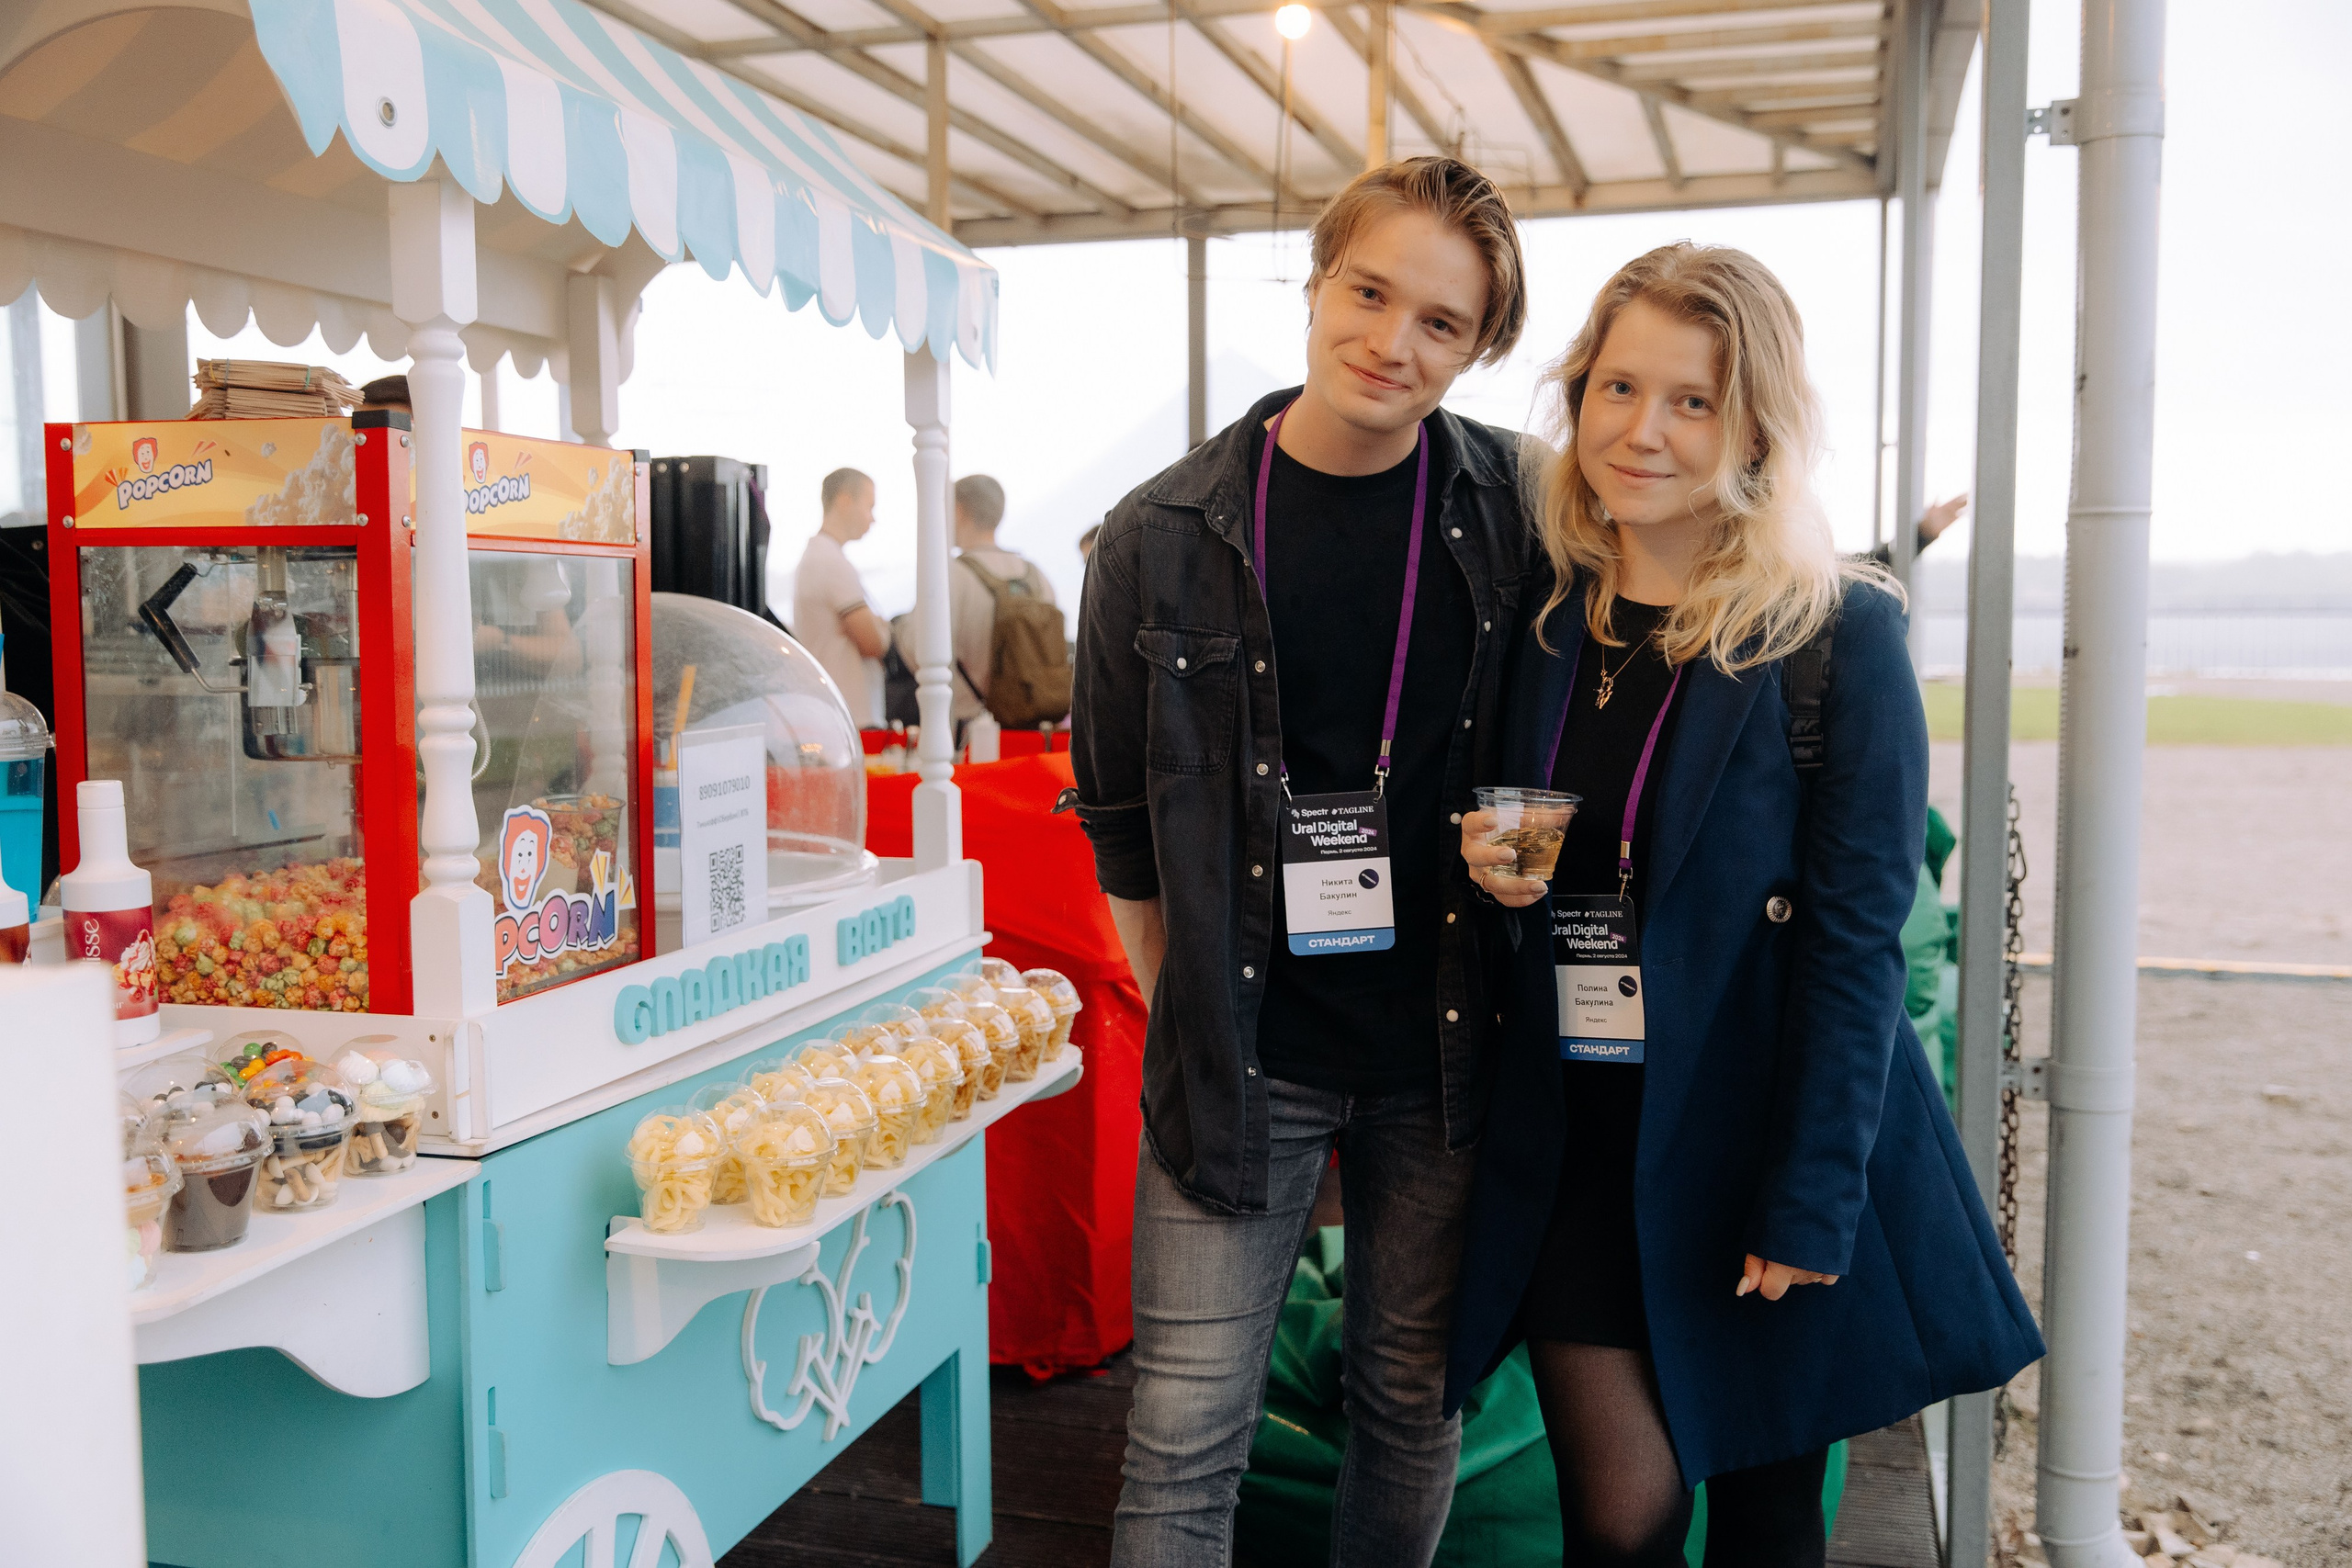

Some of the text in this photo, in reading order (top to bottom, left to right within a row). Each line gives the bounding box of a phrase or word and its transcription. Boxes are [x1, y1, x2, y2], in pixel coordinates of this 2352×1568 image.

[117, 458, 212, 510] POPCORN
[1301, 806, 1374, 818] Spectr TAGLINE
[1292, 819, 1357, 835] Ural Digital
[1361, 828, 1374, 836] 2024
[1310, 833, 1367, 846] Weekend
[1319, 892, 1357, 900] Бакулин
[1556, 909, 1581, 919] Spectr
[495, 889, 615, 976] PCORN
[1572, 924, 1608, 939] Digital
[1611, 933, 1624, 942] 2024
[82, 918, 101, 964] isse
[1308, 935, 1375, 948] СТАНДАРТ
[1566, 938, 1618, 950] Weekend
[614, 895, 915, 1045] СЛАДКАЯ ВАТА
[1577, 984, 1608, 992] Полина
[1575, 998, 1613, 1008] Бакулина
[1569, 1043, 1630, 1055] СТАНДАРТ
